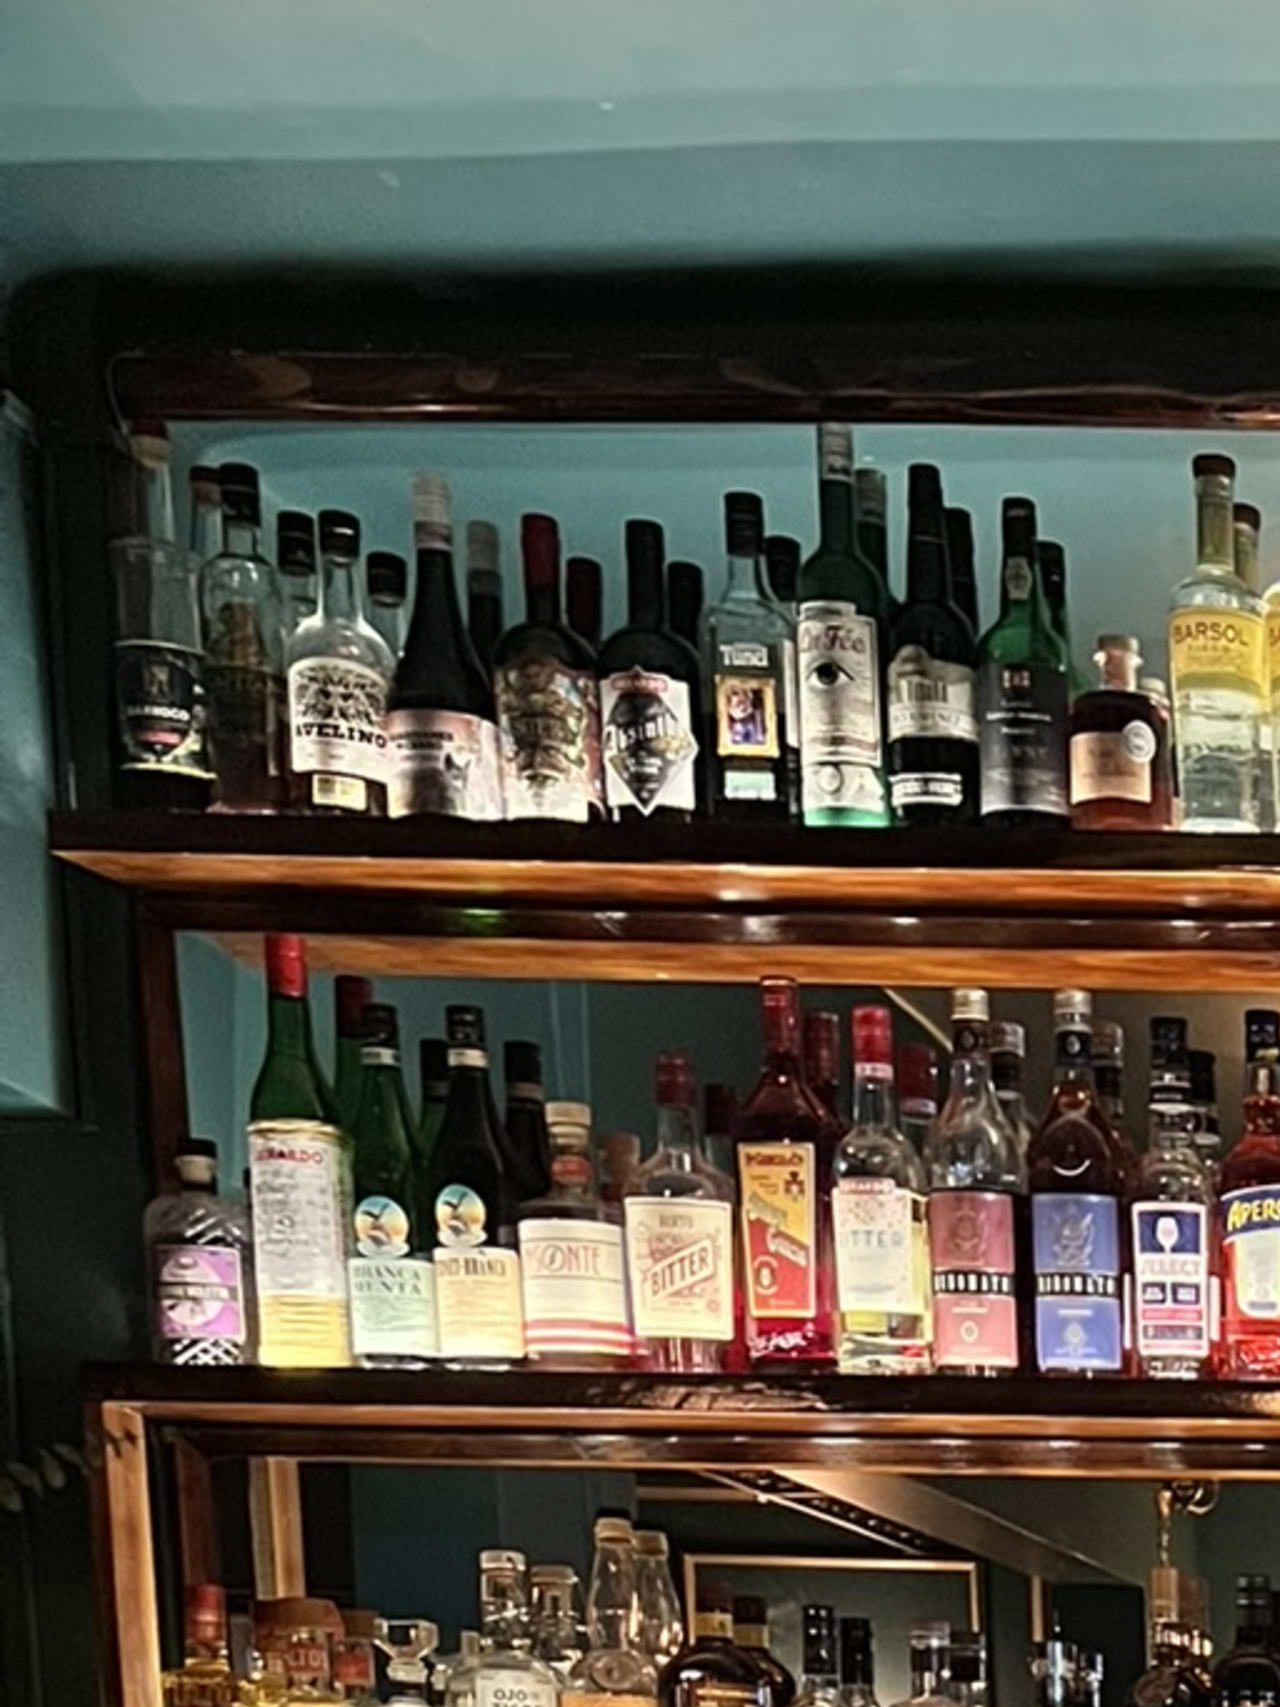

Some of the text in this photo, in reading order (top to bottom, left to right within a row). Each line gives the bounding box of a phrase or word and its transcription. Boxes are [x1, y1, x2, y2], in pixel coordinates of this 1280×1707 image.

[1173, 621, 1249, 646] BARSOL
[296, 721, 388, 748] AVELINO
[650, 1249, 711, 1300] BITTER
[493, 1689, 528, 1702] OJO
